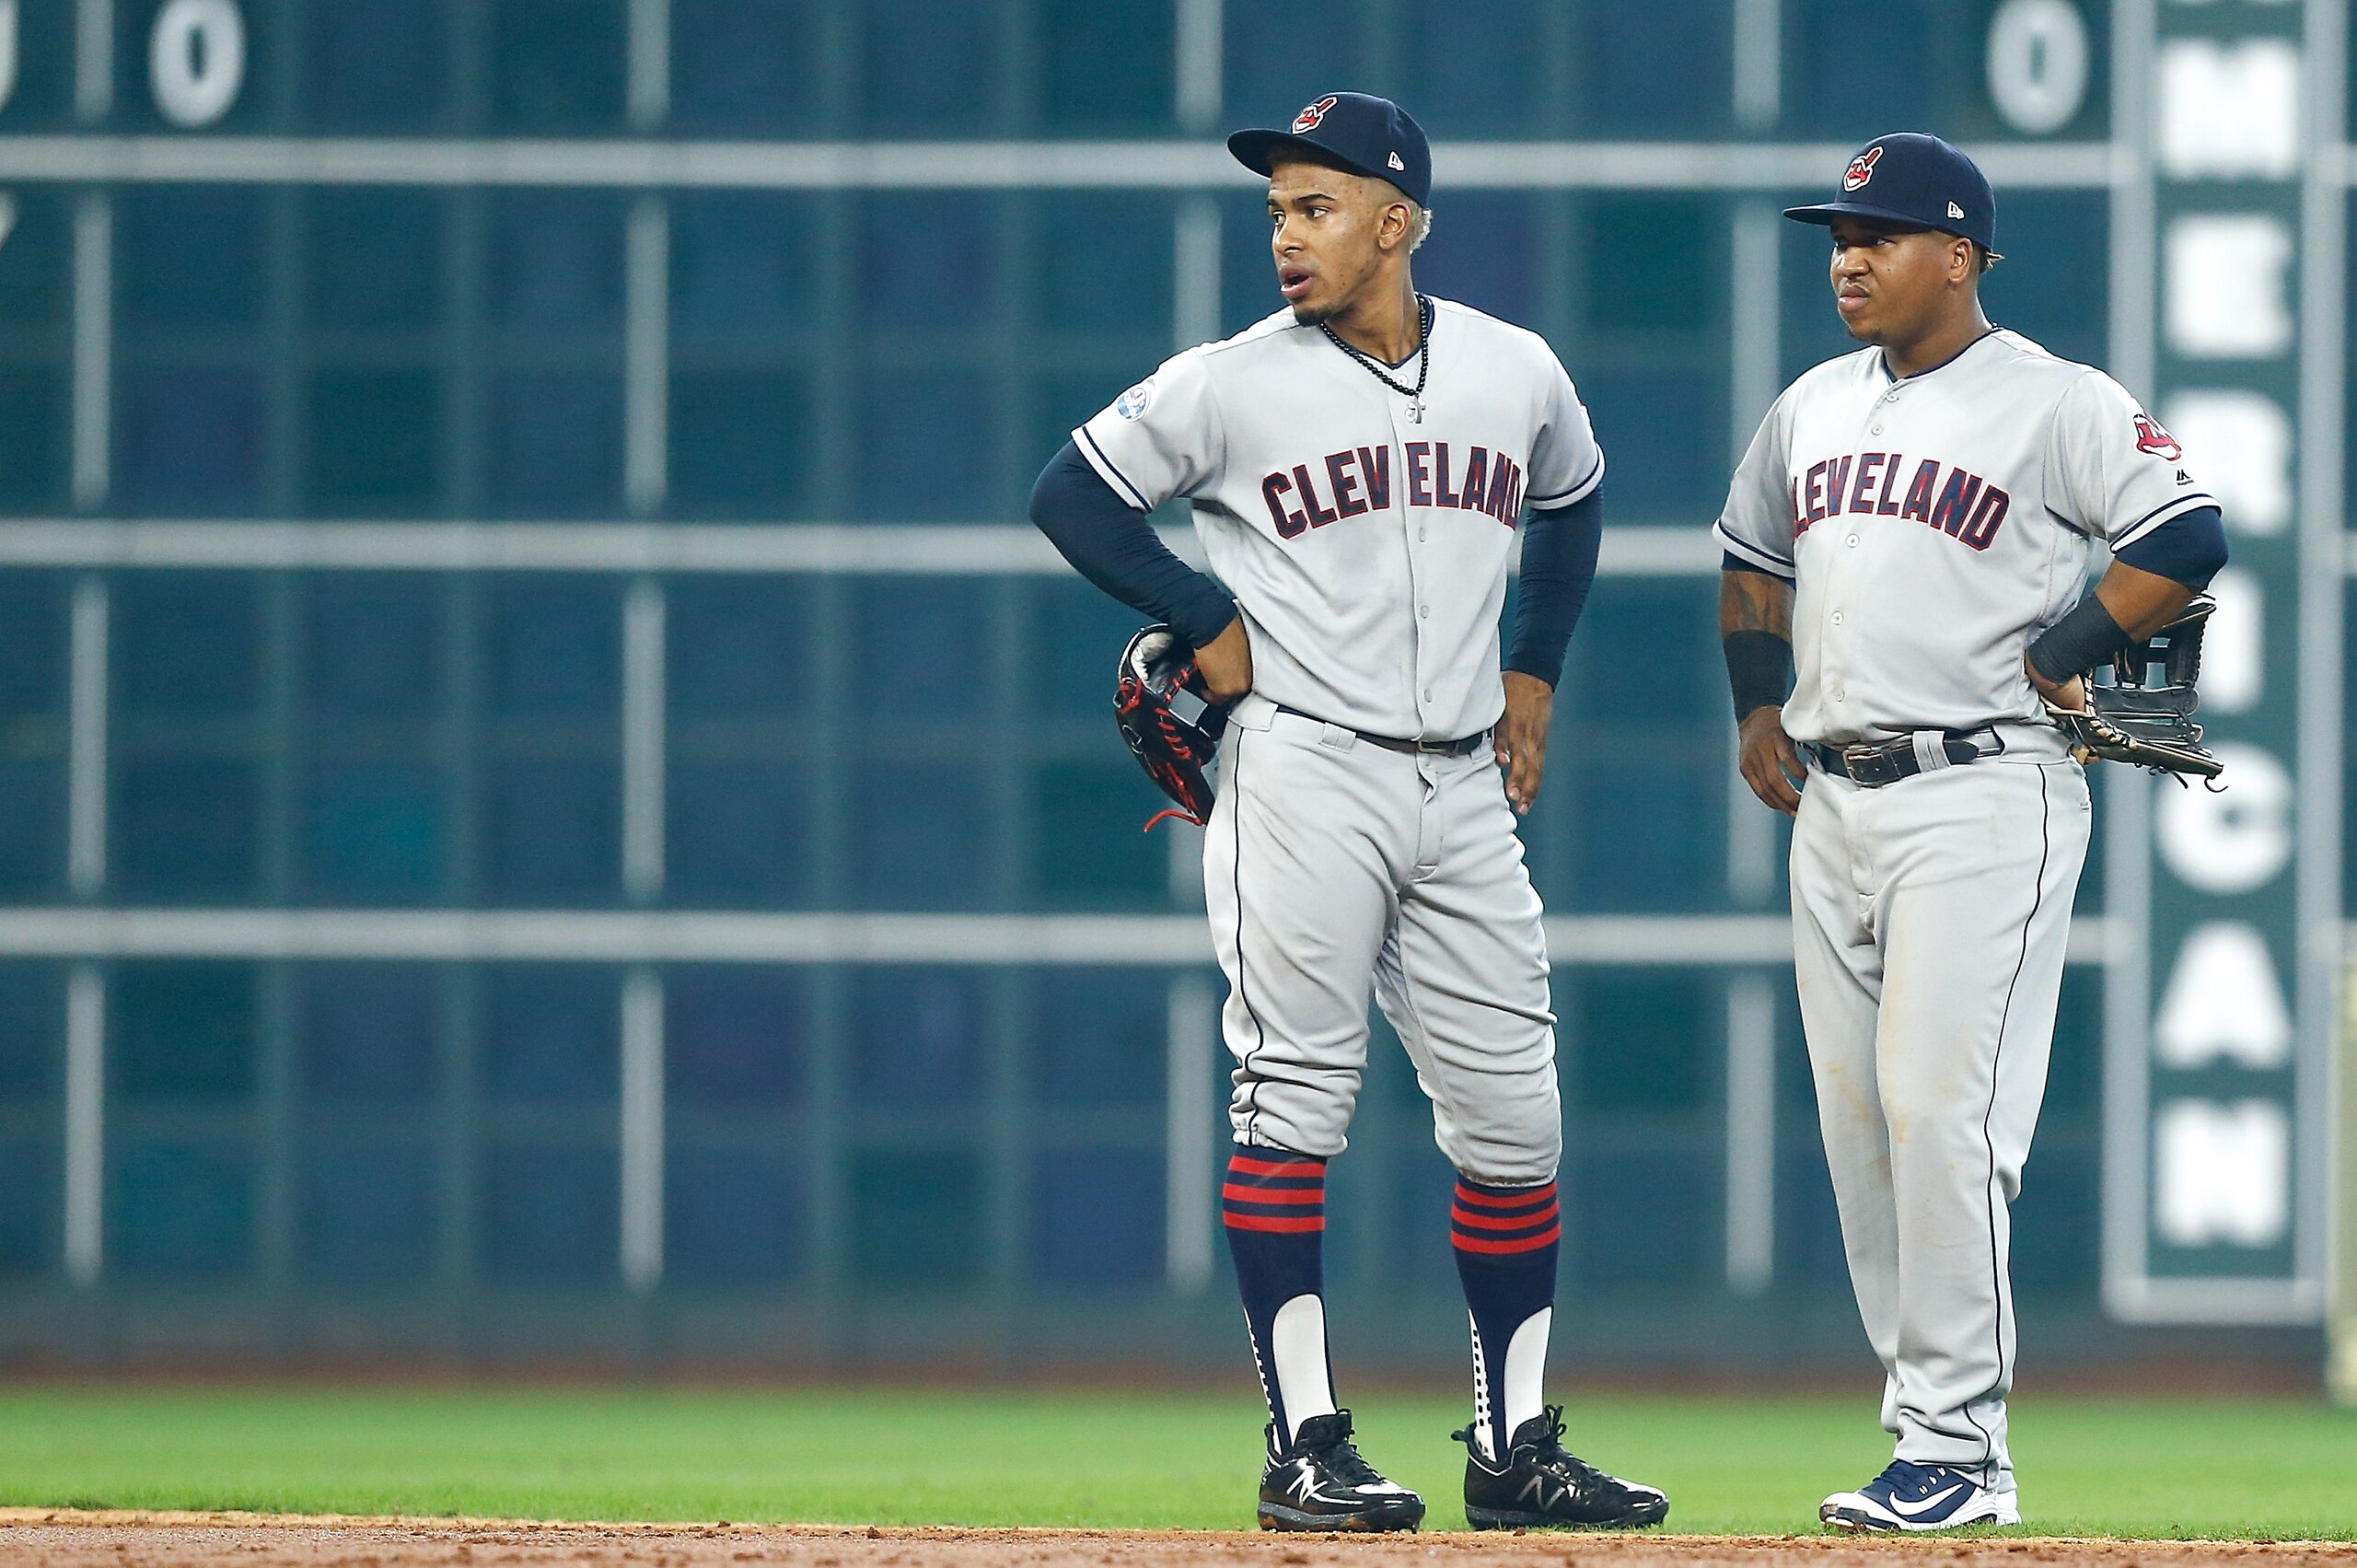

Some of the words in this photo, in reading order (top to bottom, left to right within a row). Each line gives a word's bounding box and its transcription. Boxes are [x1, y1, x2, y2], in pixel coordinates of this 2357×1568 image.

[1261, 441, 1522, 540] CLEVELAND
[1793, 452, 2010, 552] LEVELAND
[2155, 0, 2300, 1249] MERICAN
